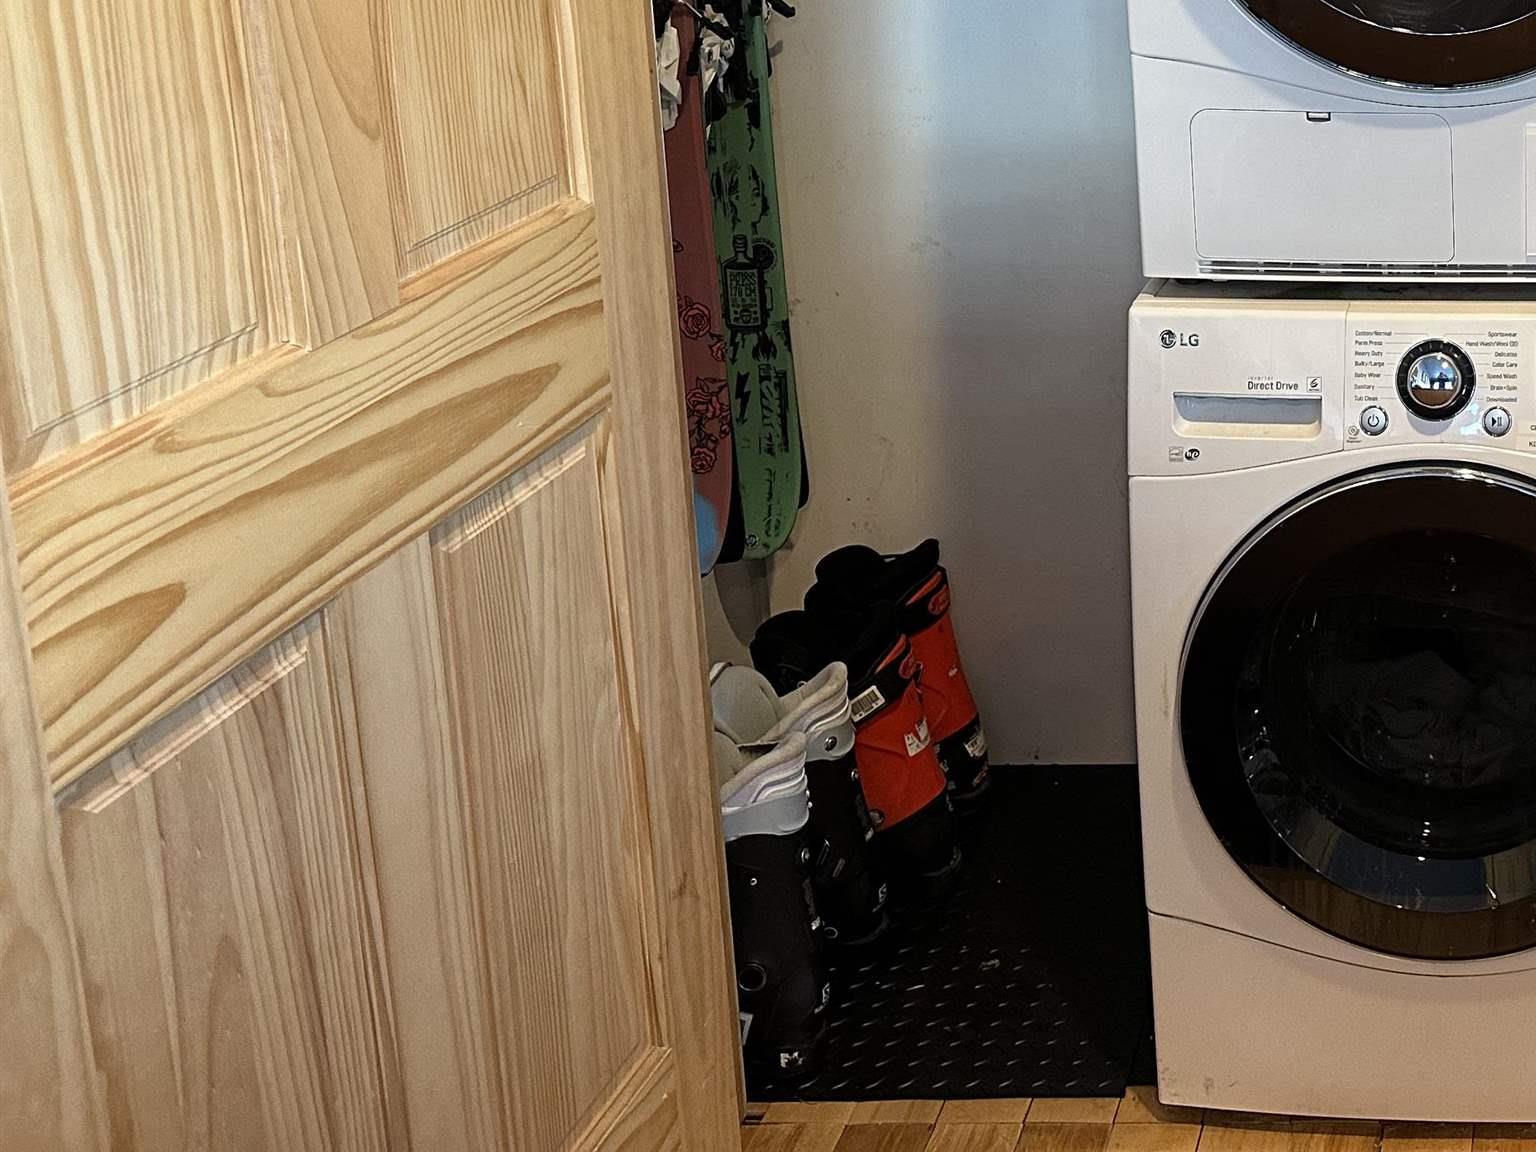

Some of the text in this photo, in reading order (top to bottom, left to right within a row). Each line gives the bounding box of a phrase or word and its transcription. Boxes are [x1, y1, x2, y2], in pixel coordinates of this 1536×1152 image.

[1180, 333, 1200, 347] LG
[1247, 381, 1299, 391] Direct Drive
